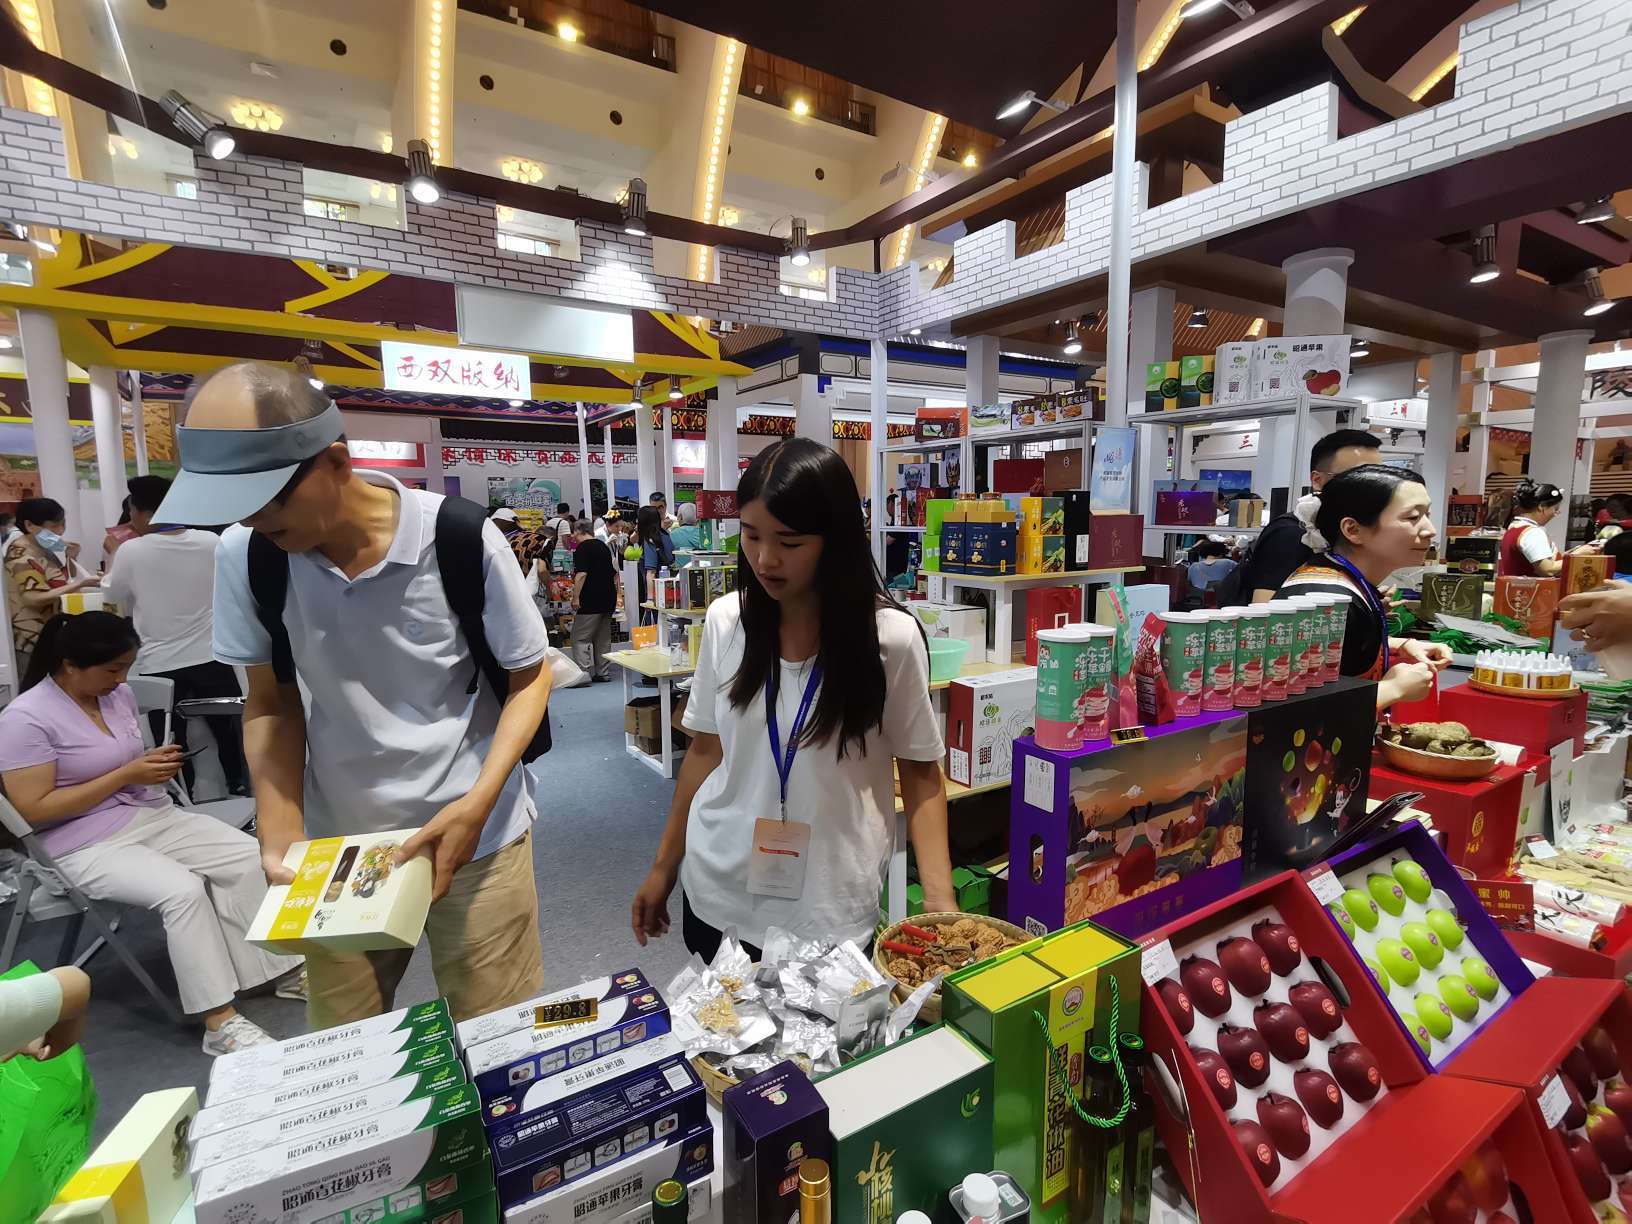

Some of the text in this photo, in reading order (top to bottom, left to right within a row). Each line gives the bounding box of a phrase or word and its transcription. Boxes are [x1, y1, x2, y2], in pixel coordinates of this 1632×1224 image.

[396, 355, 520, 391] 西双版纳
[544, 1001, 587, 1022] ¥29.8
[281, 1162, 392, 1213] 昭通青花椒牙膏
[574, 1176, 644, 1219] 昭通苹果牙膏
